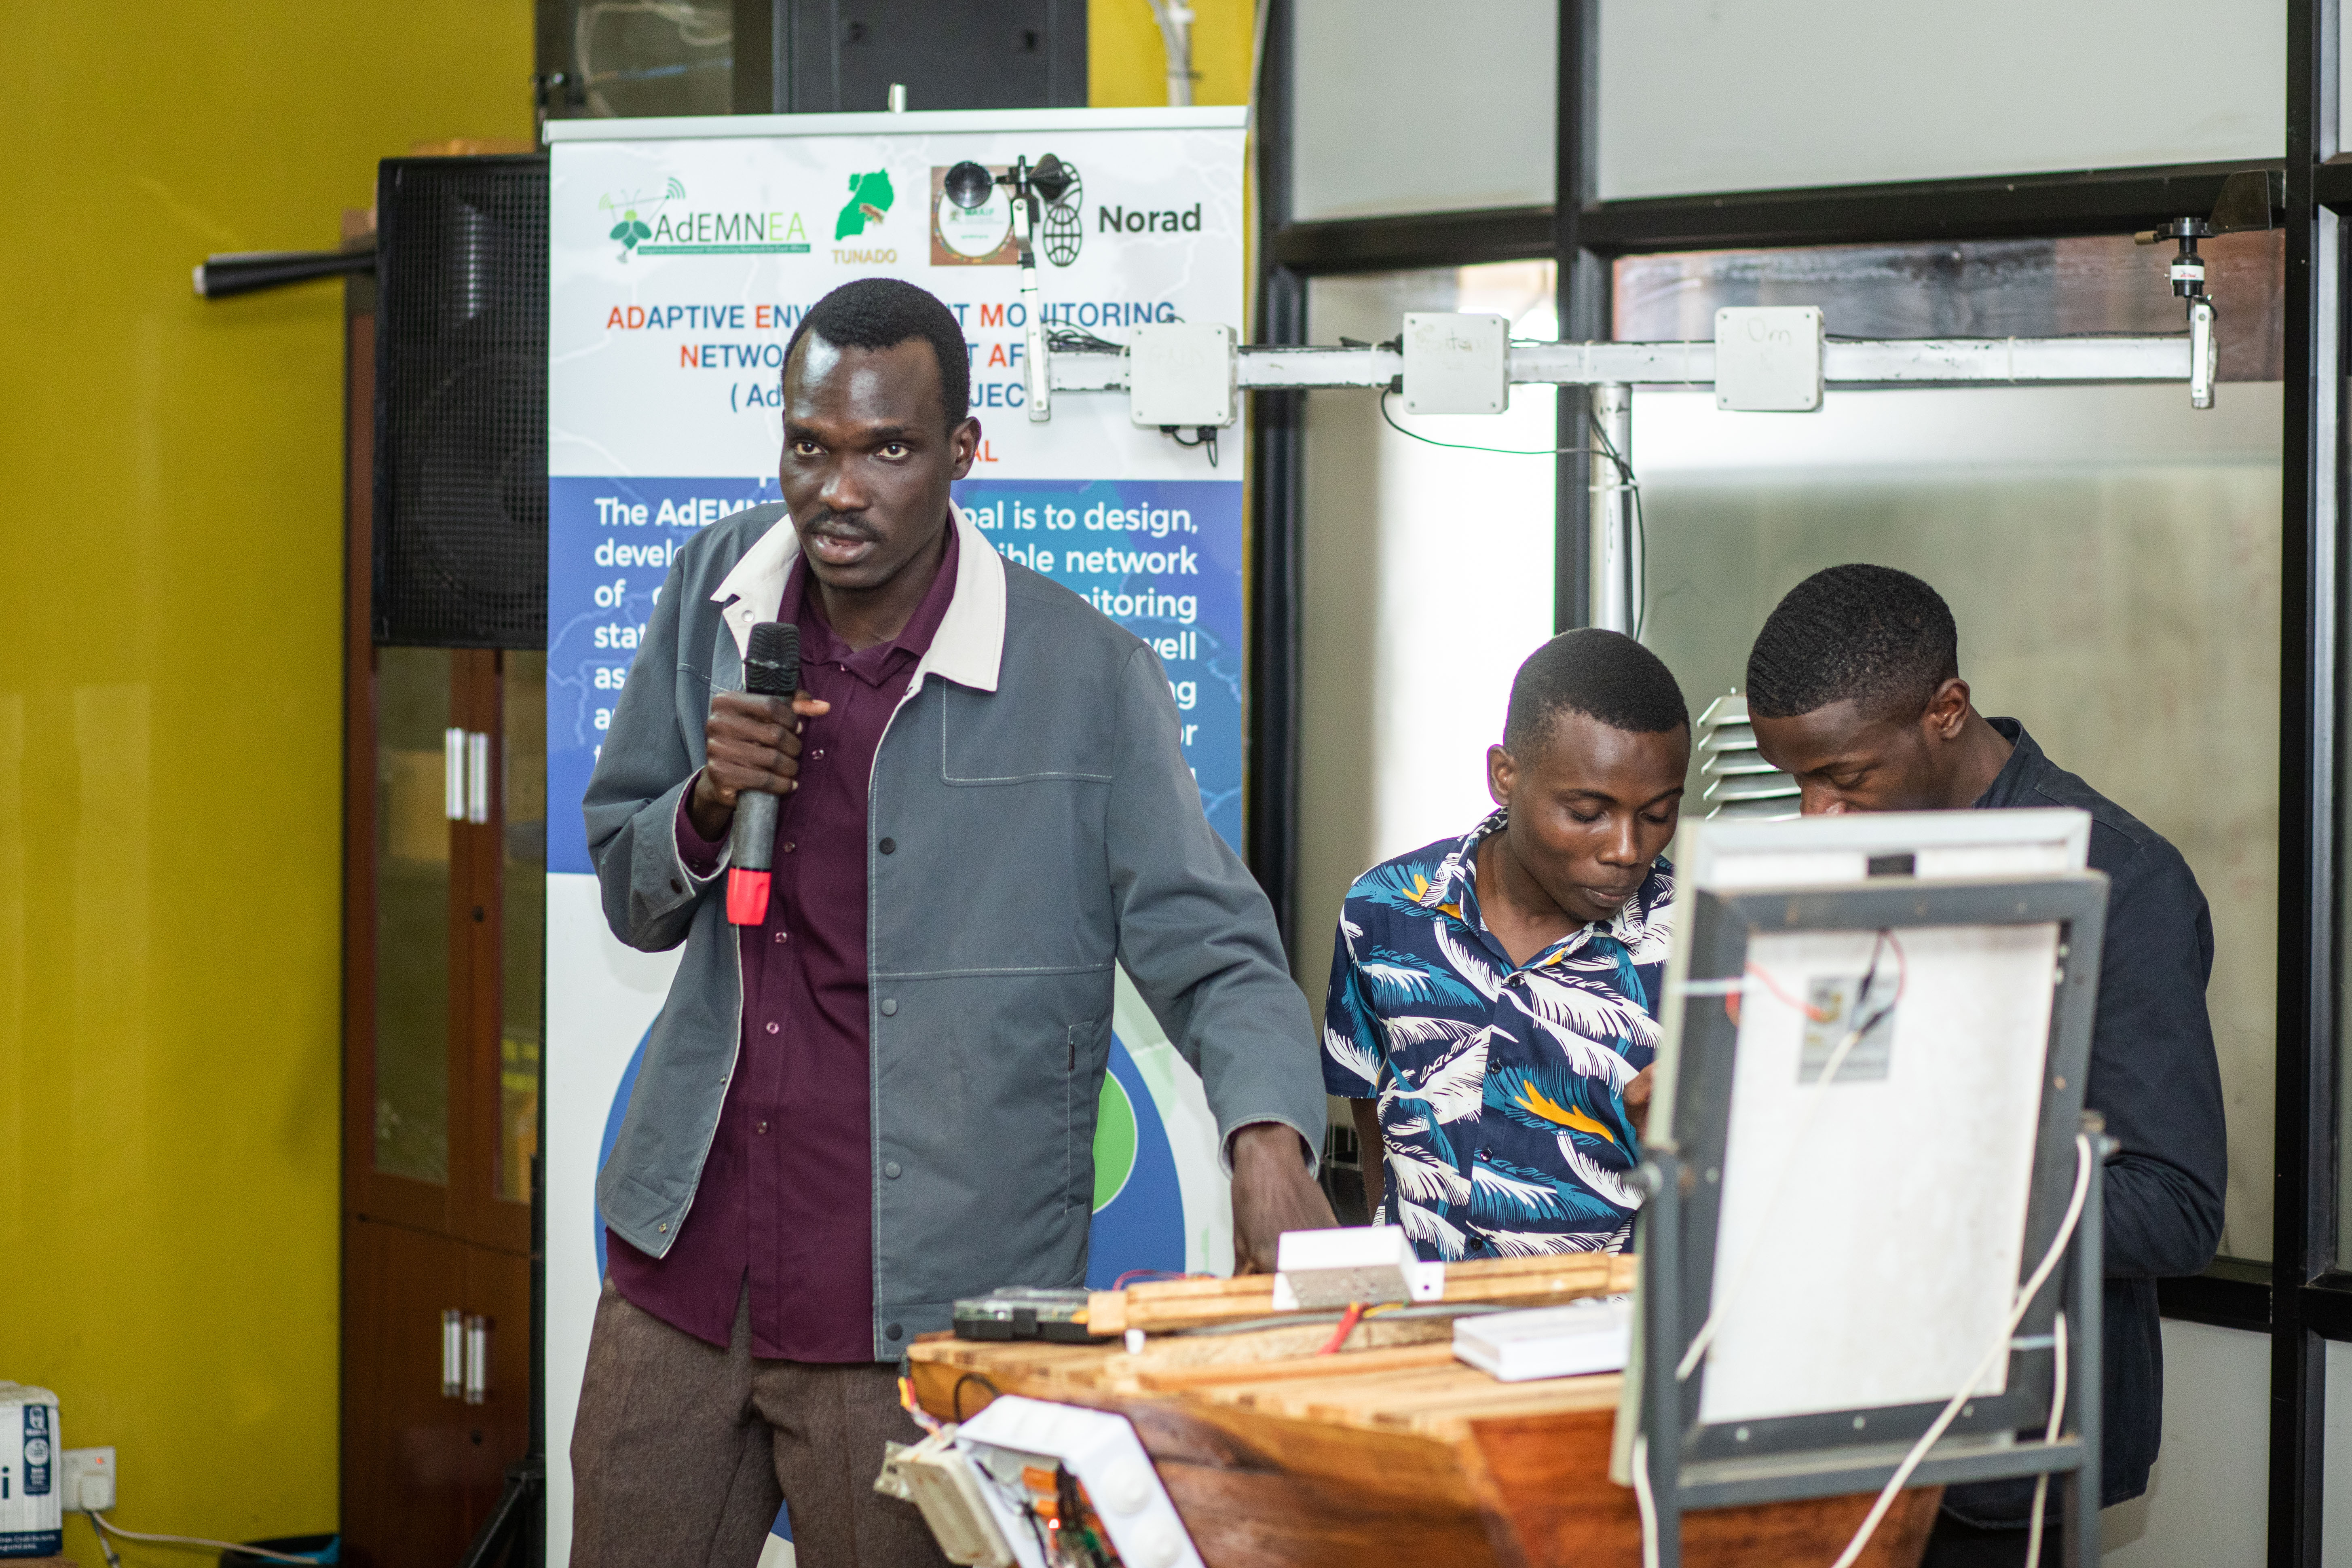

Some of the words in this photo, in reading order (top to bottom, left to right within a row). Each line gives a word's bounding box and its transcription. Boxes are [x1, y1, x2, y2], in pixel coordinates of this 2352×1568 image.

[654, 212, 806, 243] AdEMNEA
[1099, 202, 1202, 233] Norad
[832, 249, 897, 264] TUNADO
[607, 305, 745, 329] ADAPTIVE
[681, 344, 784, 368] NETWO
[594, 497, 648, 526] The
[1014, 501, 1037, 529] is
[1044, 504, 1076, 530] to
[1084, 501, 1198, 537] design,
[594, 537, 682, 567] devel
[1066, 545, 1198, 574] network
[594, 578, 627, 607] of
[1080, 587, 1197, 624] itoring
[594, 667, 626, 690] as
